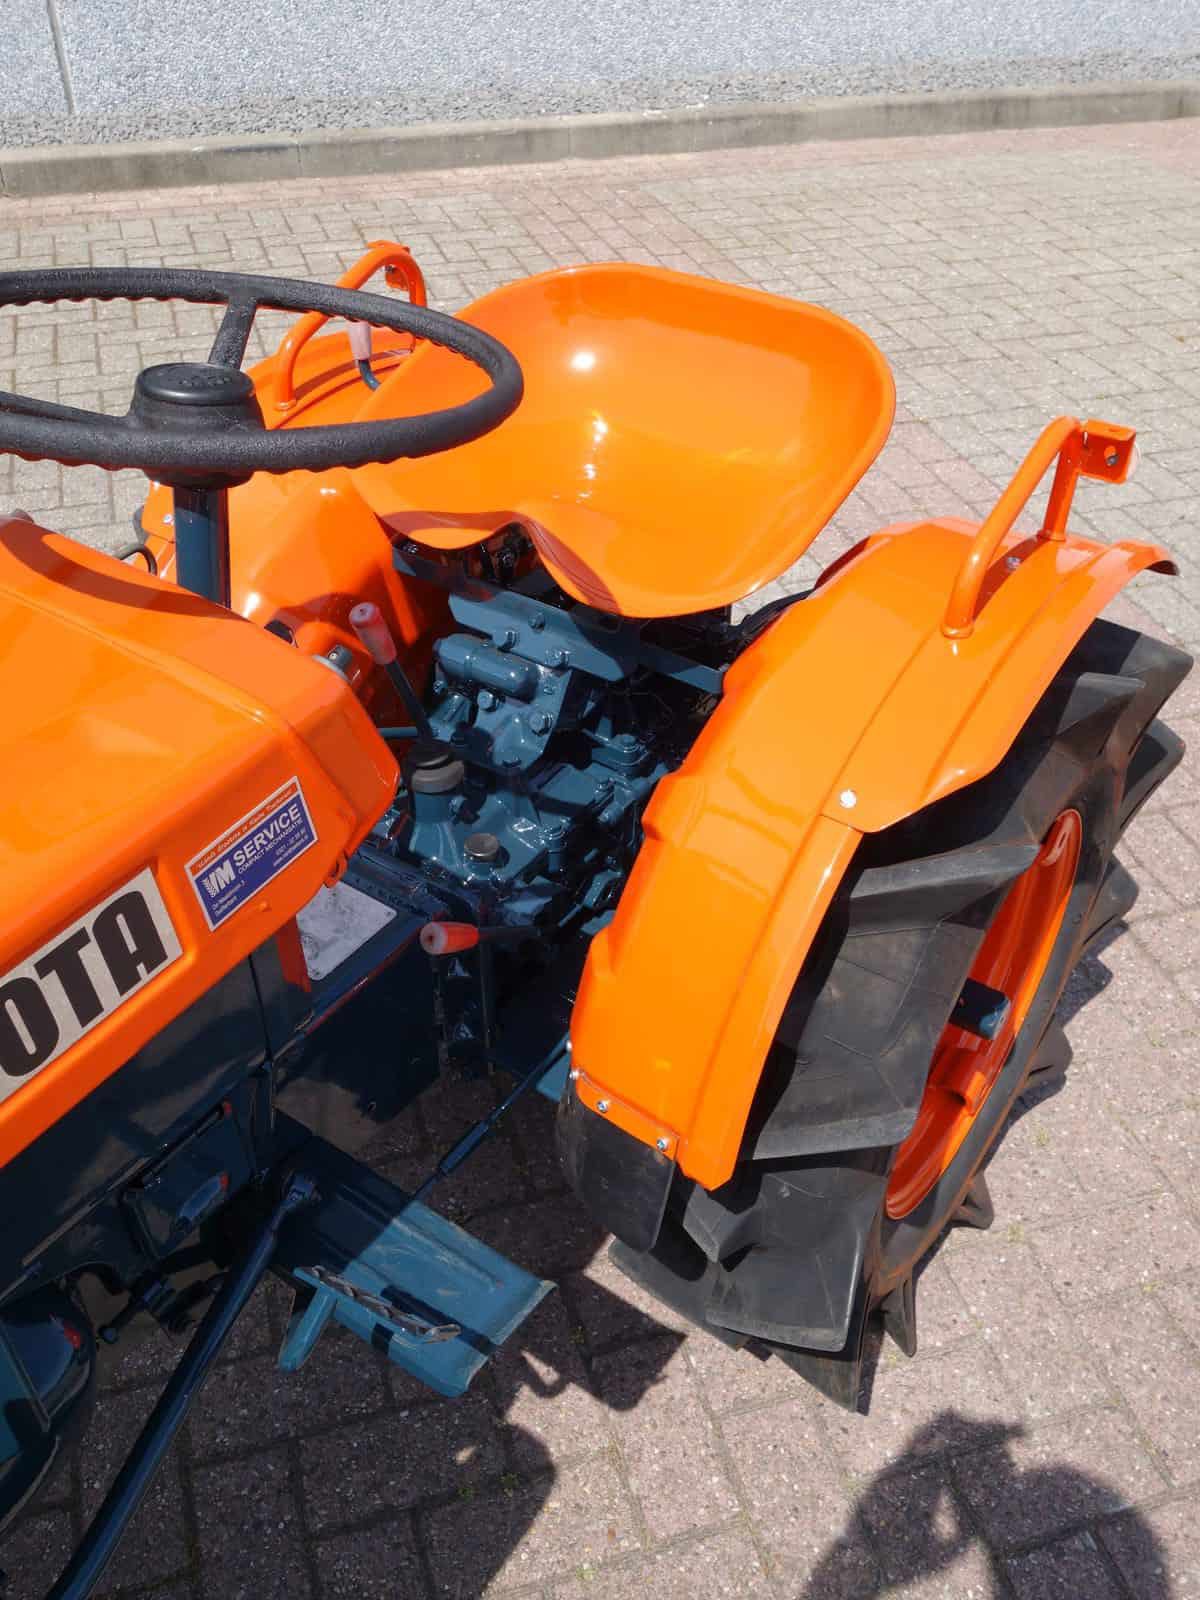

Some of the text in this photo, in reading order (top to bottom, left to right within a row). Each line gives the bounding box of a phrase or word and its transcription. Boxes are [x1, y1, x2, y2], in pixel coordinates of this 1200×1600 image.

[233, 803, 301, 866] SERVICE
[238, 847, 265, 874] COMPACT
[0, 891, 168, 1077] OTA
